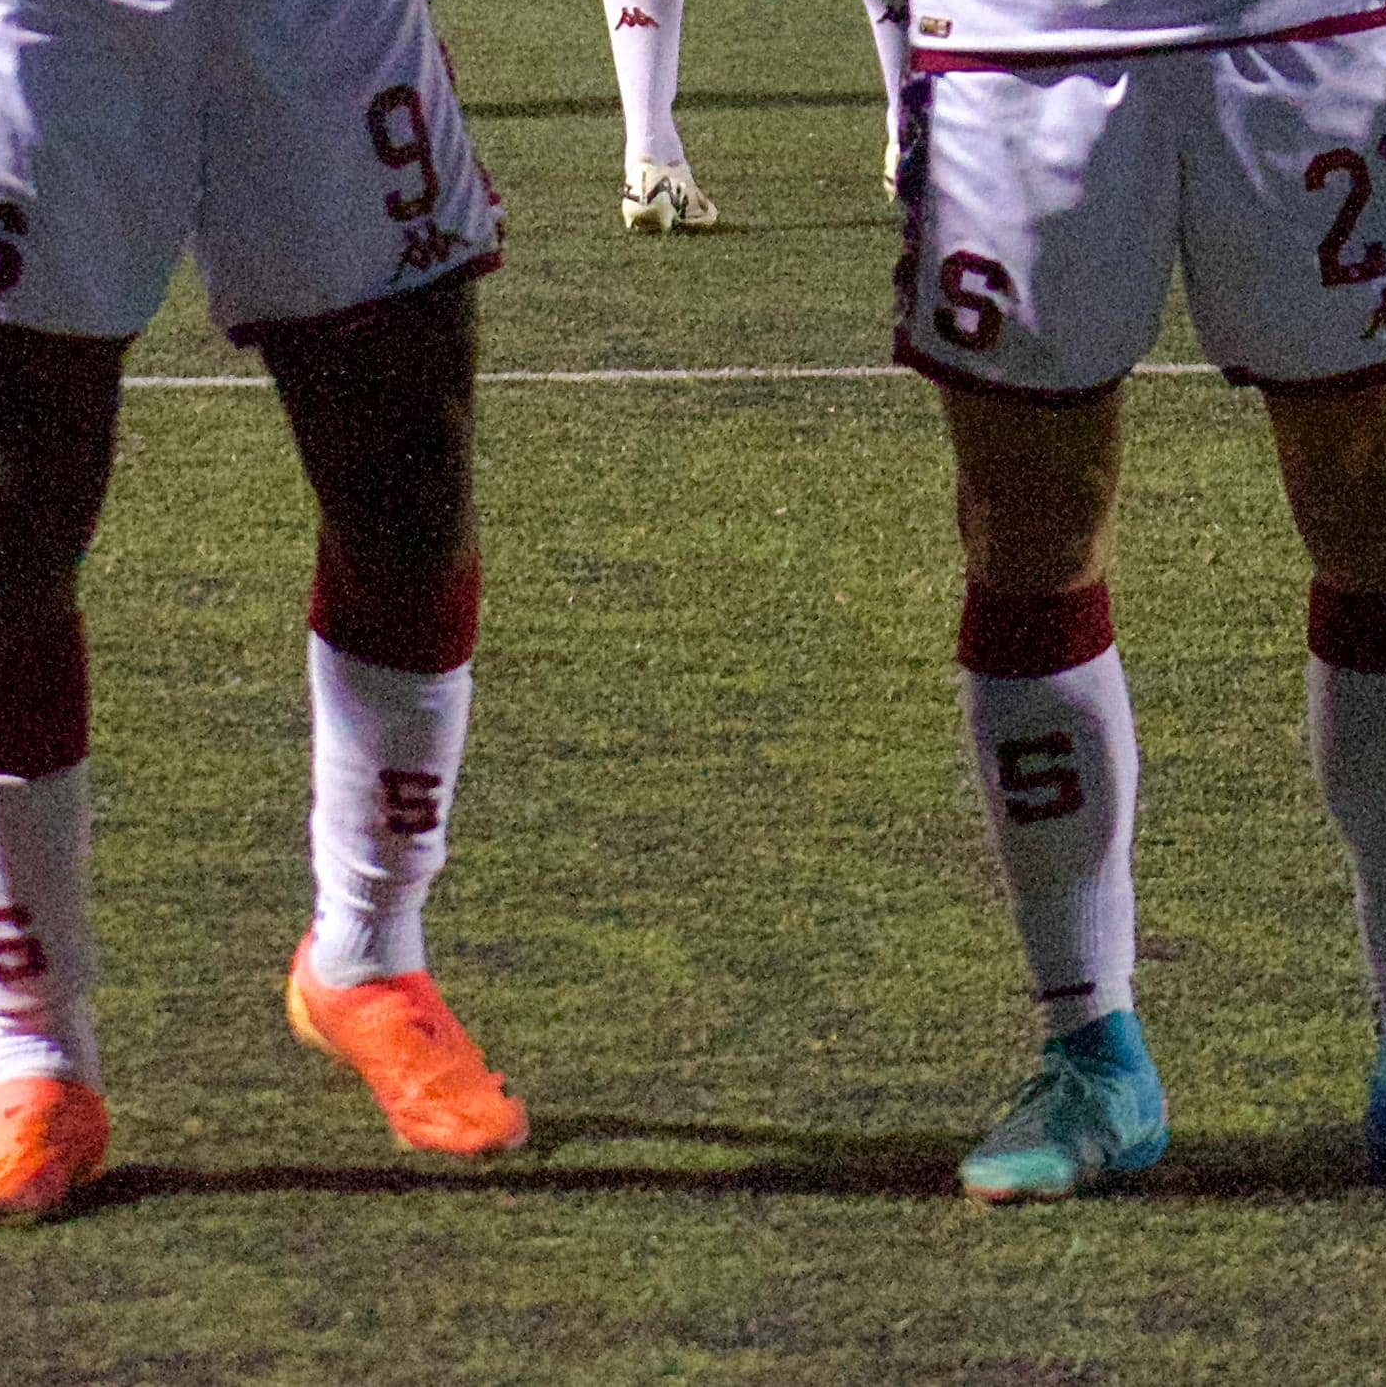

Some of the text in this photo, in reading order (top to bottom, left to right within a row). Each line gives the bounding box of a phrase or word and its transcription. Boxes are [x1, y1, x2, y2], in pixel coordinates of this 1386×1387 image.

[366, 84, 441, 222] 9
[933, 249, 1013, 351] S
[996, 731, 1085, 826] S
